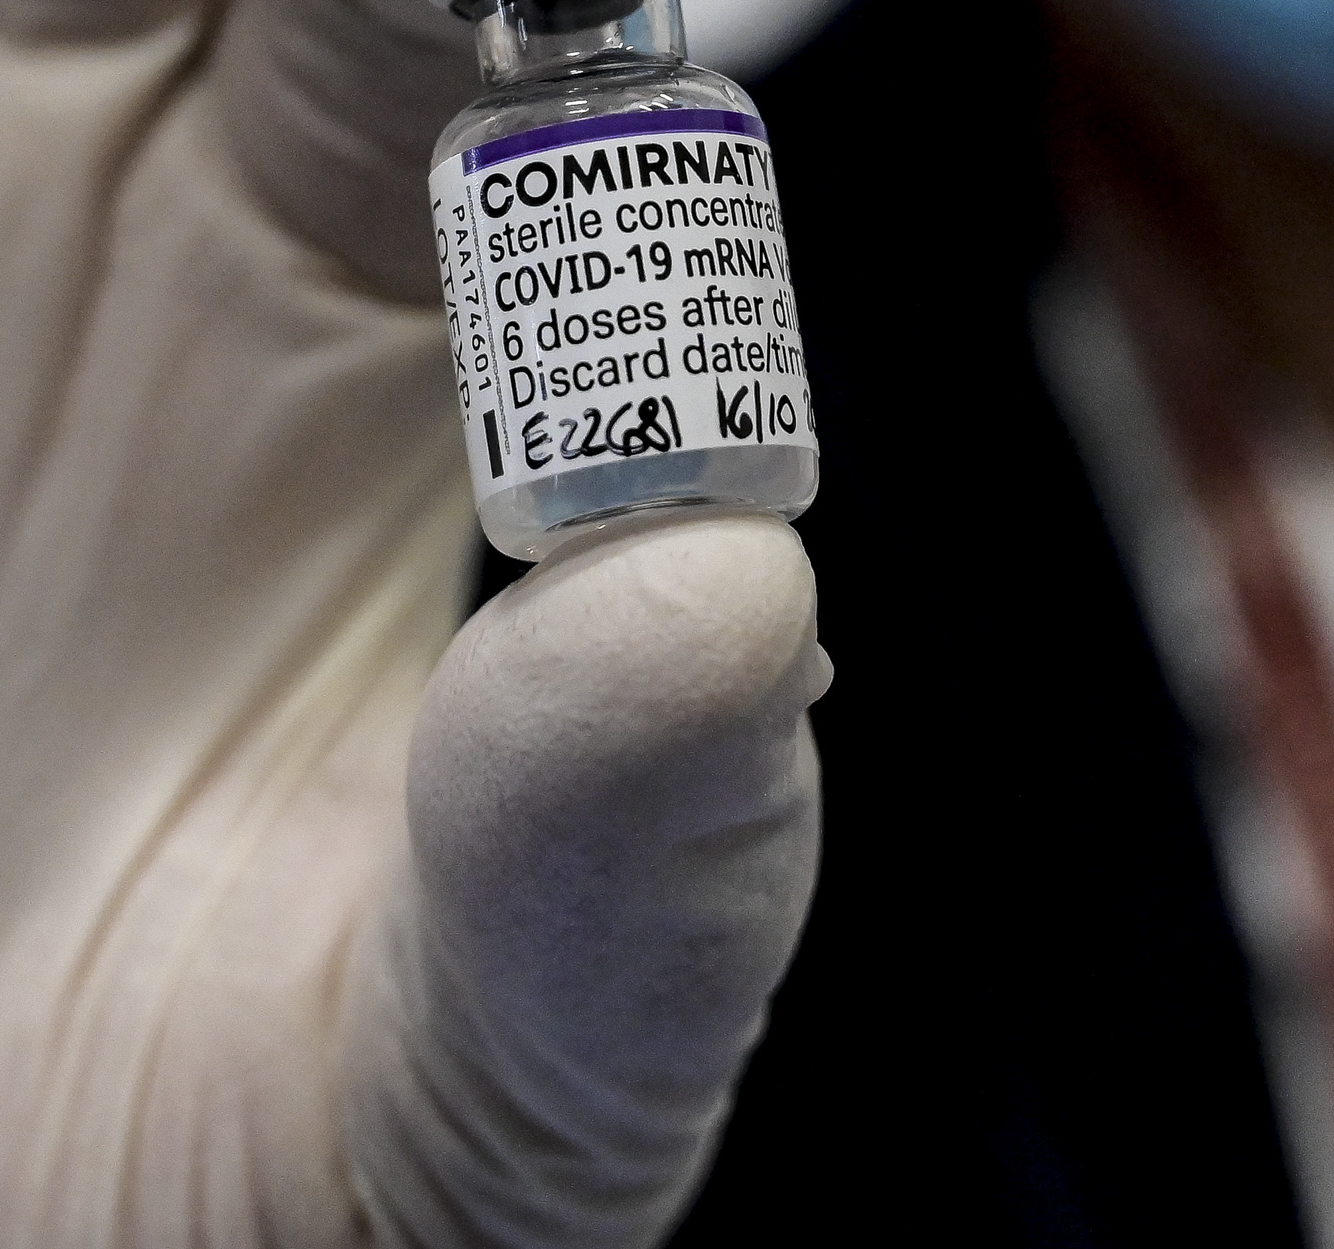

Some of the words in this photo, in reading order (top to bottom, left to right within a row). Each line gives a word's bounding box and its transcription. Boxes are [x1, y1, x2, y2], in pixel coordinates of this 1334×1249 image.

[480, 140, 770, 219] COMIRNATY
[488, 201, 602, 264] sterile
[616, 192, 784, 233] concentrat
[452, 204, 492, 392] PAA174601
[495, 241, 673, 312] COVID-19
[685, 237, 774, 280] mRNA
[502, 321, 524, 361] 6
[536, 301, 667, 352] doses
[682, 285, 764, 329] after
[772, 288, 800, 333] dil
[510, 337, 668, 410] Discard
[682, 332, 807, 376] date/tim
[716, 376, 797, 444] 16/10
